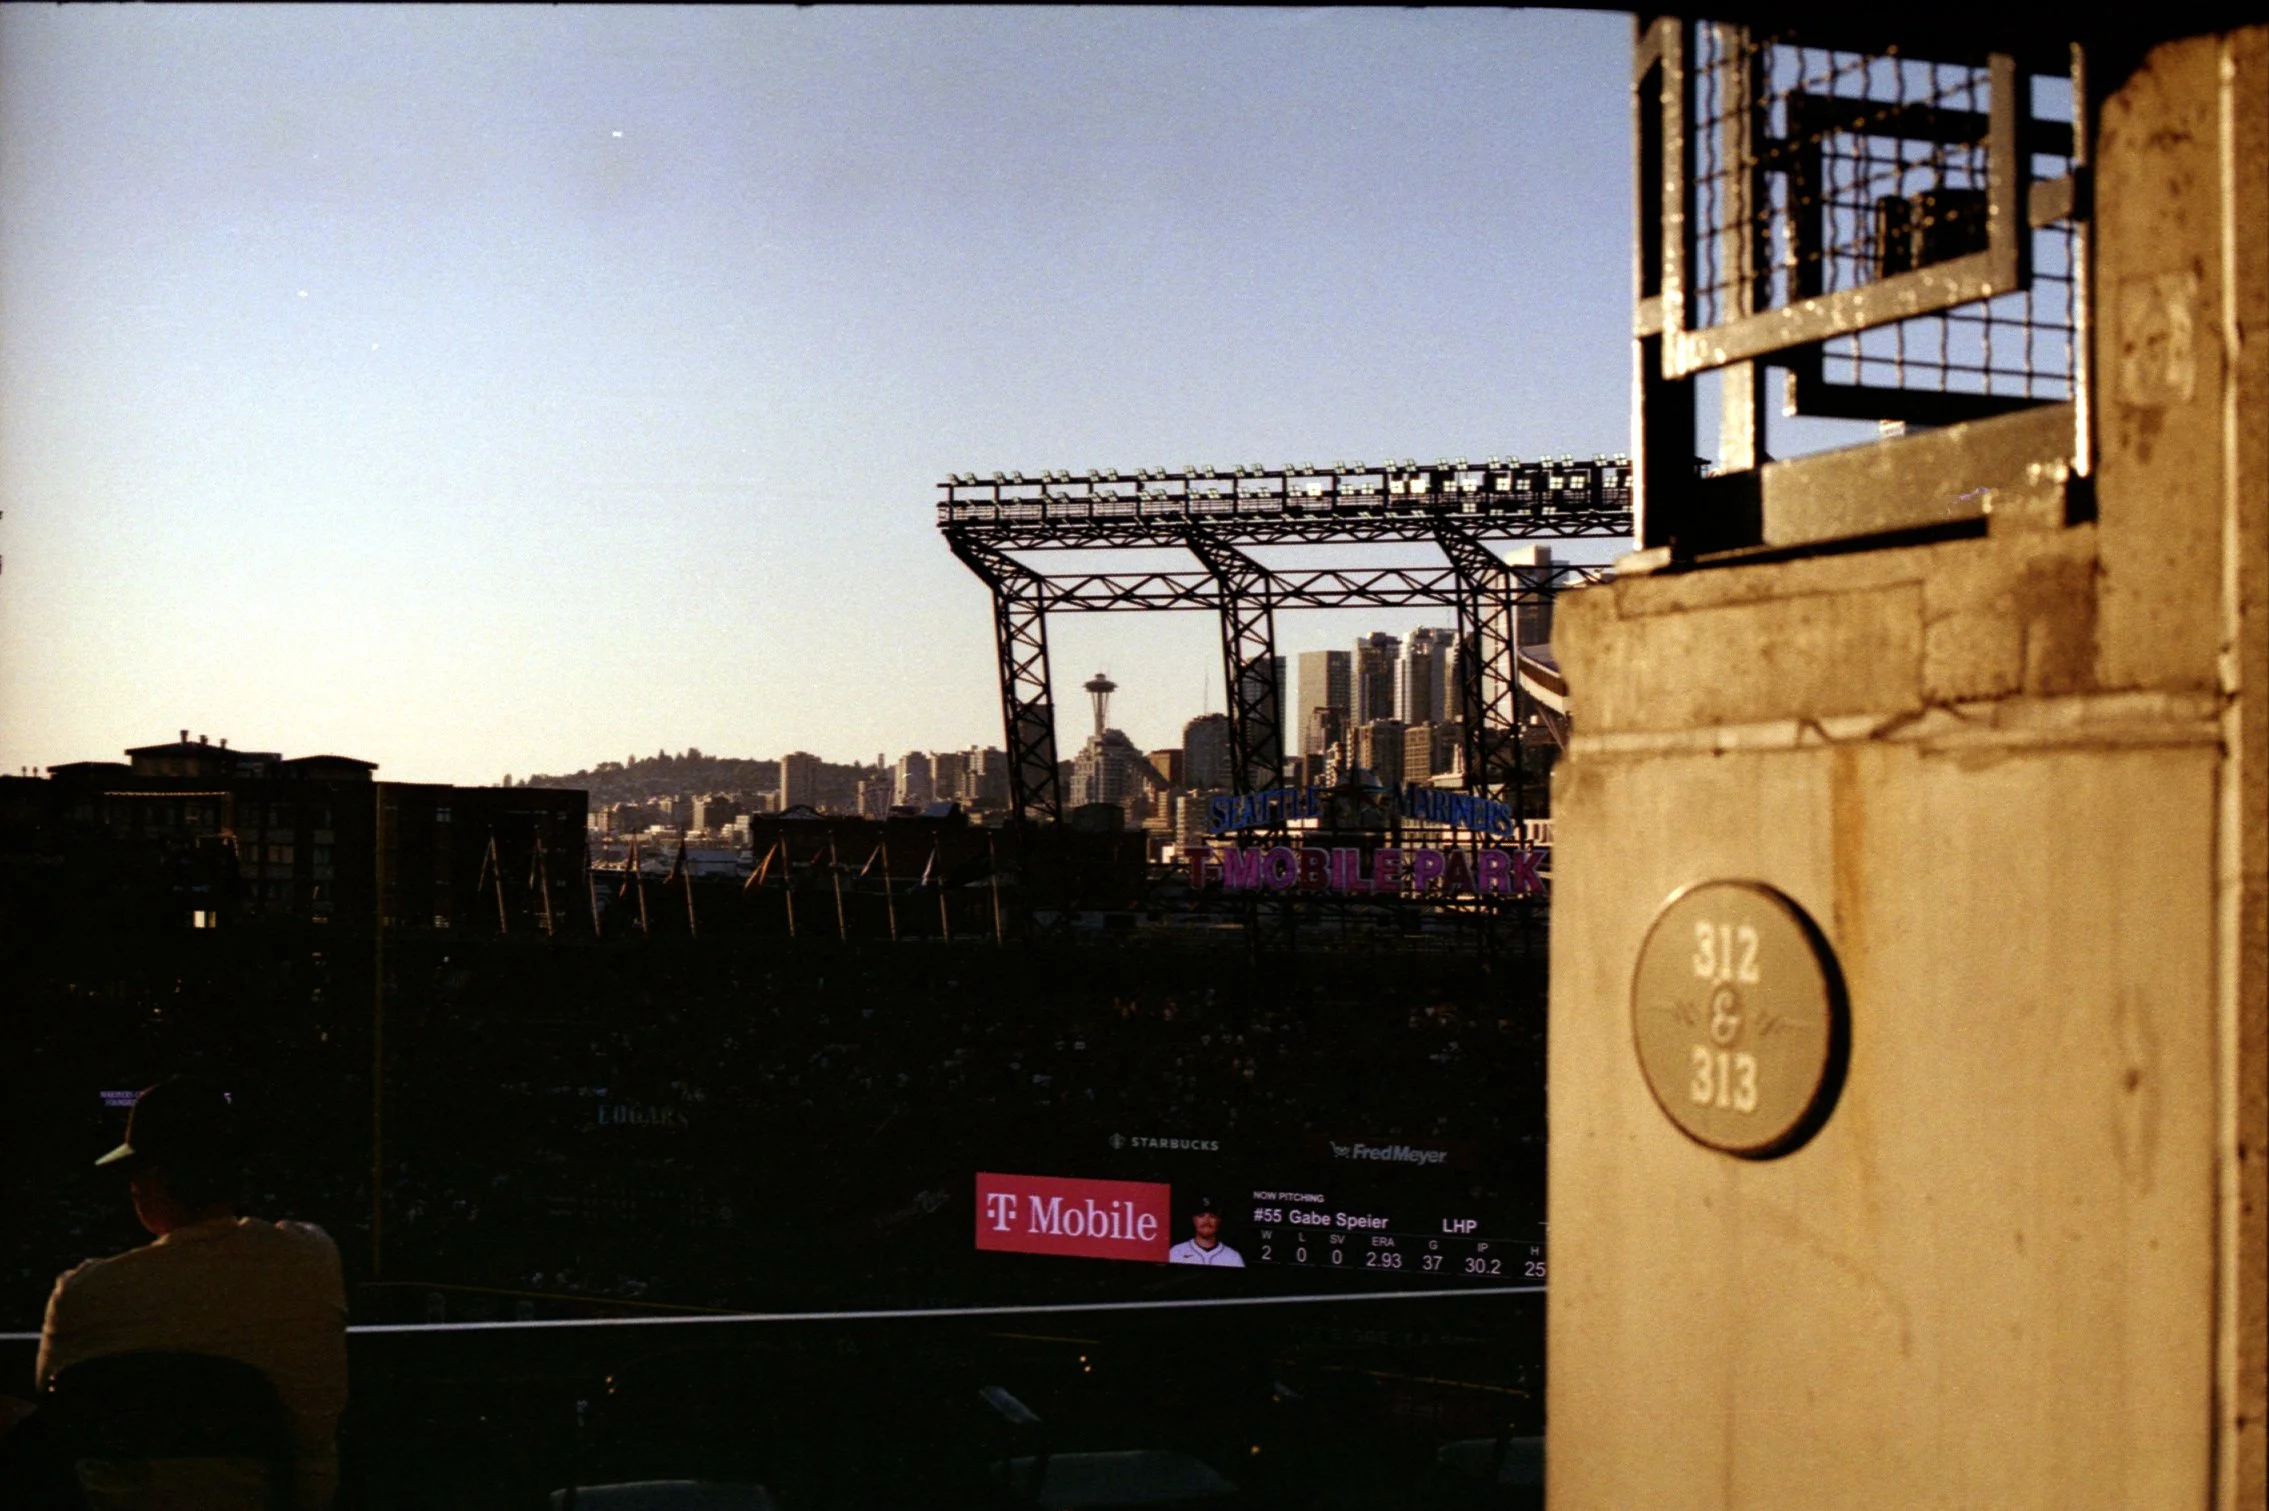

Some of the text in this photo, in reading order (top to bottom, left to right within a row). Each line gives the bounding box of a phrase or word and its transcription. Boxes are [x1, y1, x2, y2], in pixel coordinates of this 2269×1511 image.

[1207, 784, 1515, 837] SEATTLE MARINERS
[1185, 845, 1549, 894] T-MOBILE PARK
[1692, 918, 1760, 984] 312
[1710, 985, 1741, 1045] &
[1690, 1046, 1758, 1113] 313
[1131, 1136, 1220, 1153] STARBUCKS
[1027, 1195, 1158, 1242] Mobile
[1253, 1191, 1325, 1204] NOW PITCHING
[1253, 1208, 1477, 1234] #55 Gabe Speier LHP
[1260, 1230, 1540, 1256] W L SV ERA G IP H
[1261, 1245, 1272, 1260] 2
[1296, 1247, 1307, 1263] 0
[1332, 1249, 1343, 1265] 0
[1365, 1251, 1402, 1269] 2.93
[1422, 1255, 1444, 1271] 37
[1465, 1257, 1501, 1275] 30.2
